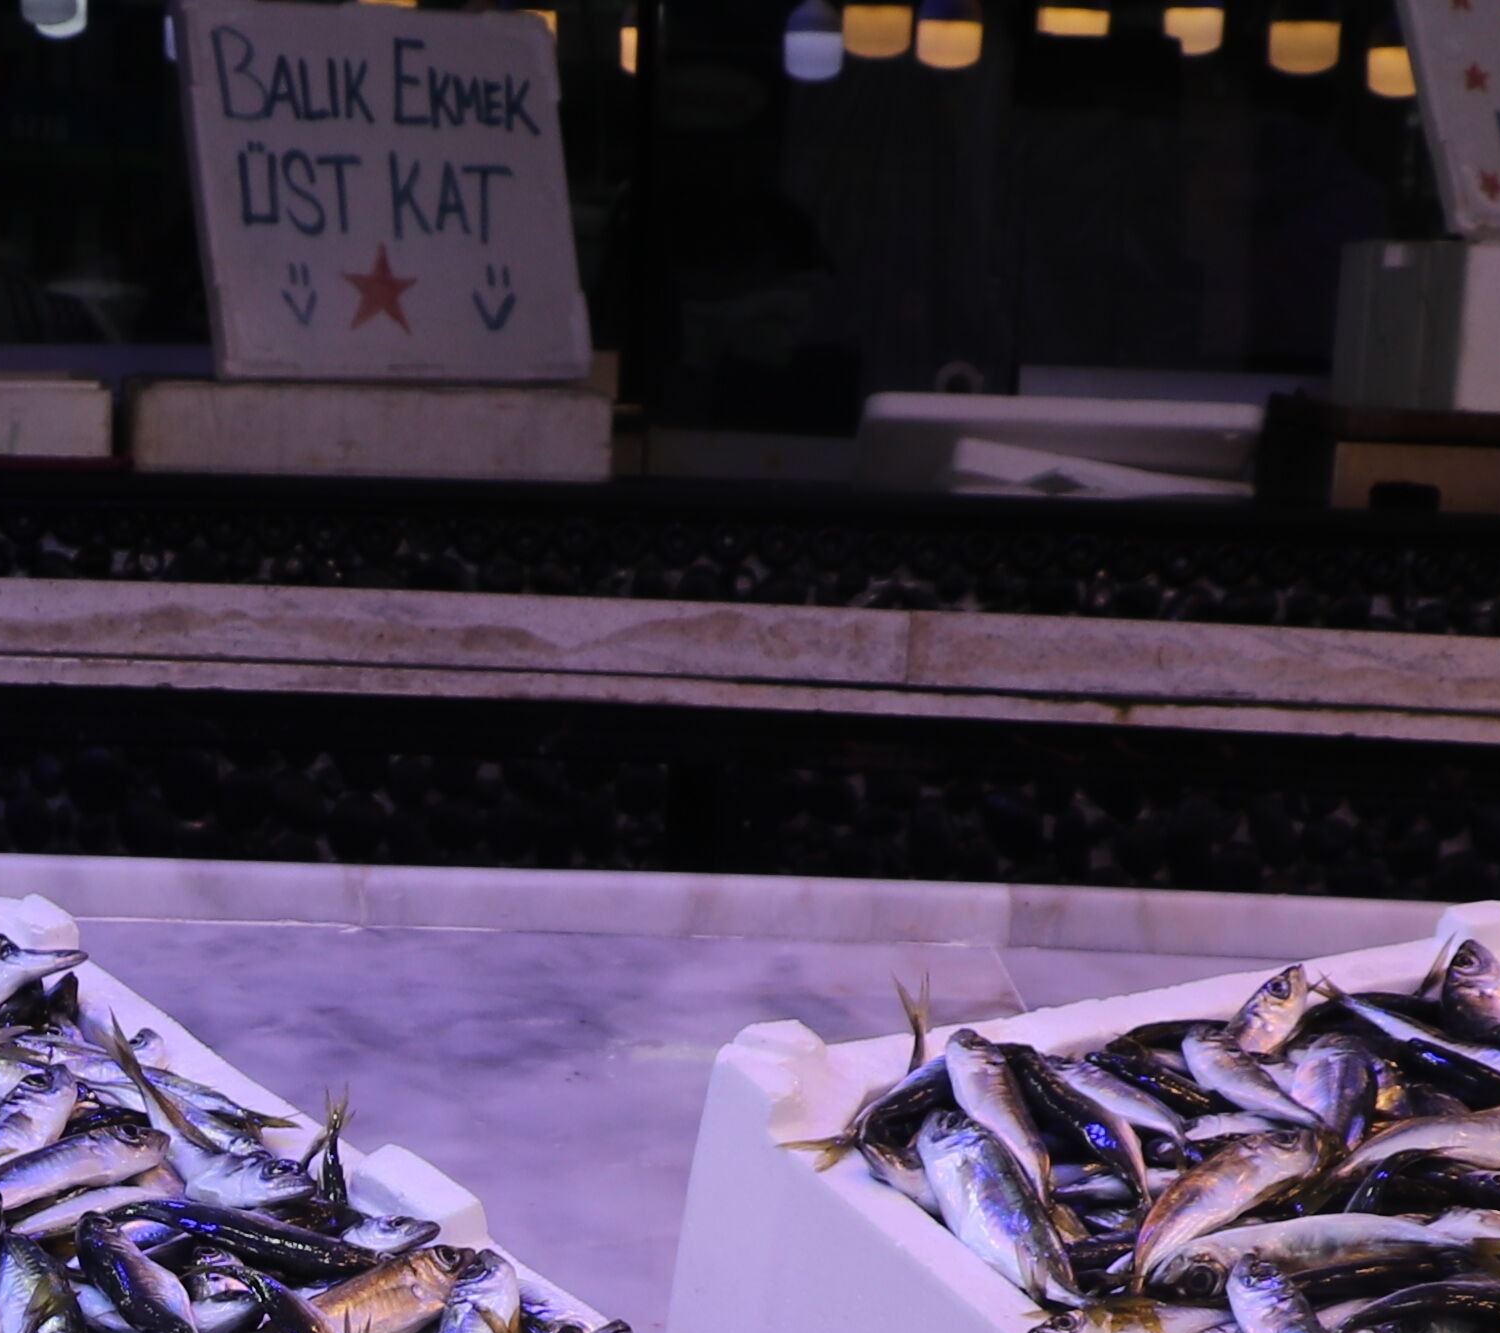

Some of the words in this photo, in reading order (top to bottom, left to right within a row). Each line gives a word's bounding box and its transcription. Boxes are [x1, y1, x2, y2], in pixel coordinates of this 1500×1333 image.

[211, 25, 375, 124] BALIK
[392, 36, 541, 136] EKMEK
[237, 141, 362, 236] ÜST
[388, 150, 514, 244] KAT
